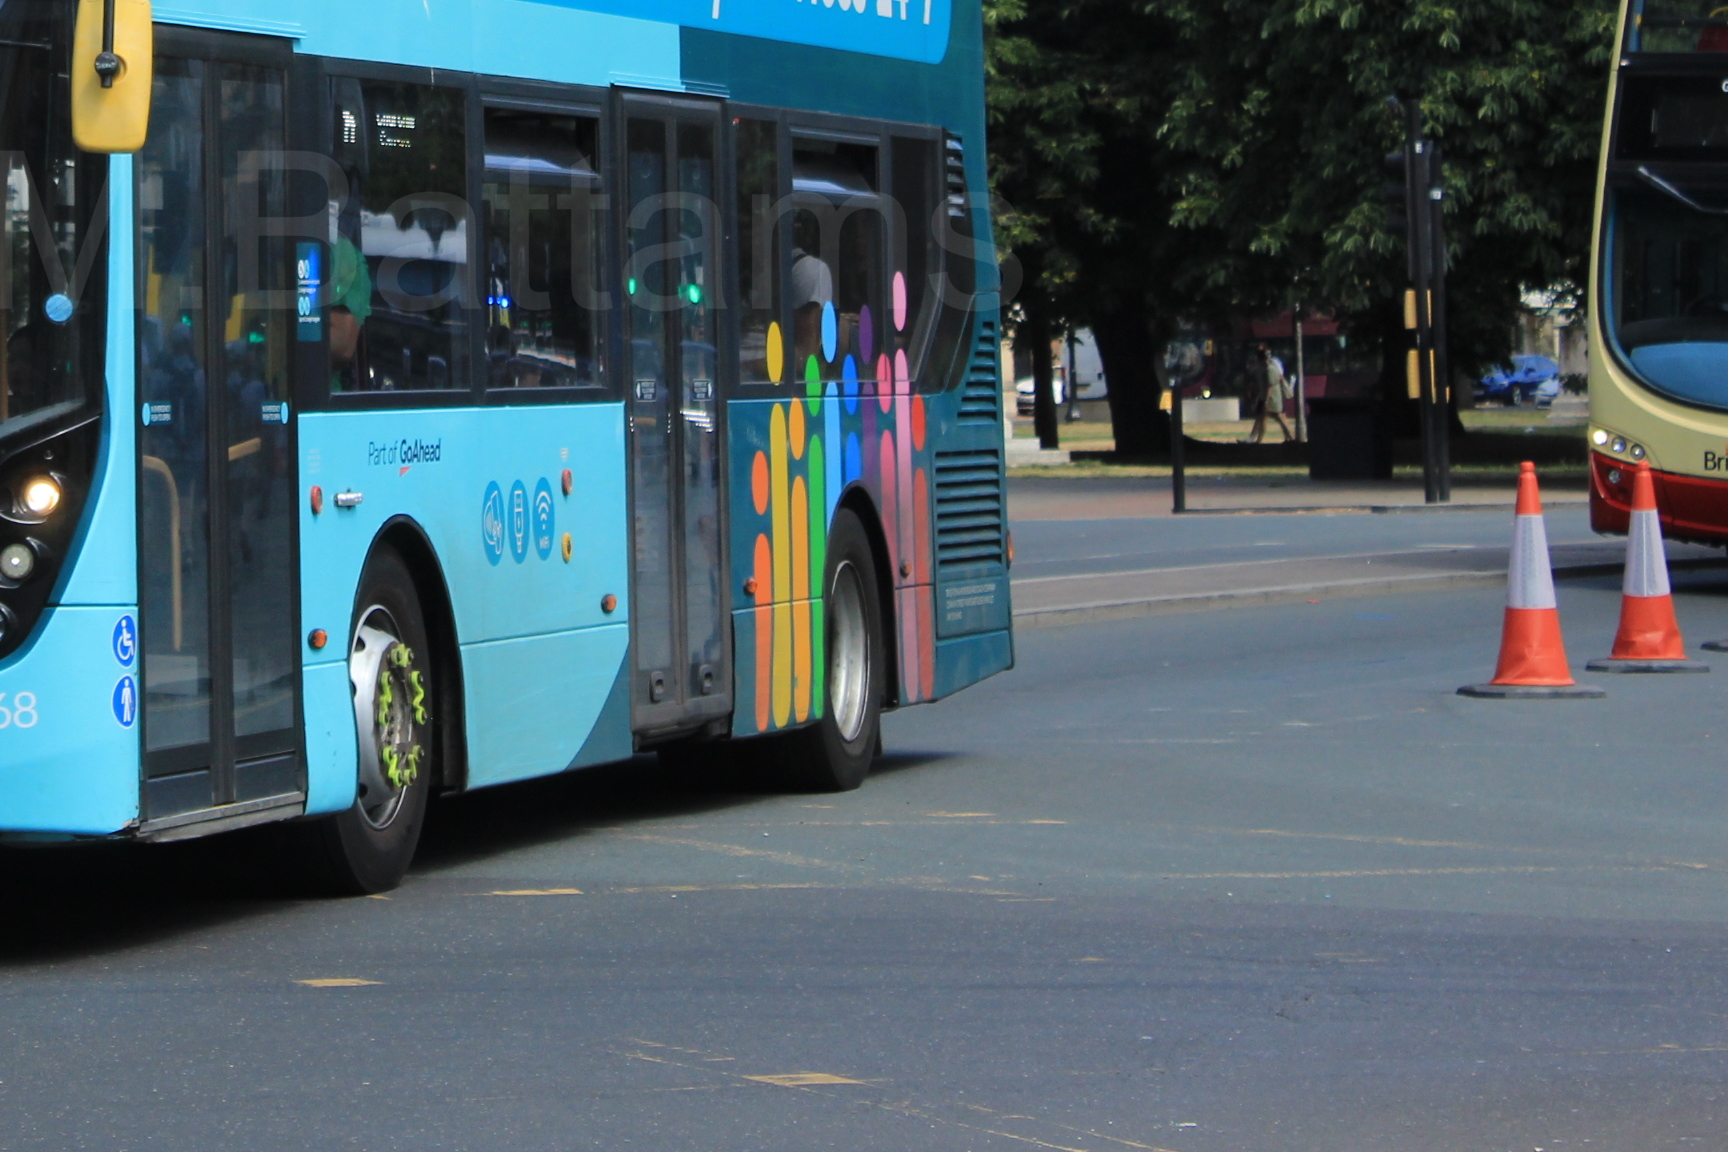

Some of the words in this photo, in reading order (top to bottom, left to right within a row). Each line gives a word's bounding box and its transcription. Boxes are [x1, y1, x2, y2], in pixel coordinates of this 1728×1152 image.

[368, 441, 386, 466] Part
[388, 440, 399, 465] of
[399, 438, 441, 464] GoAhead
